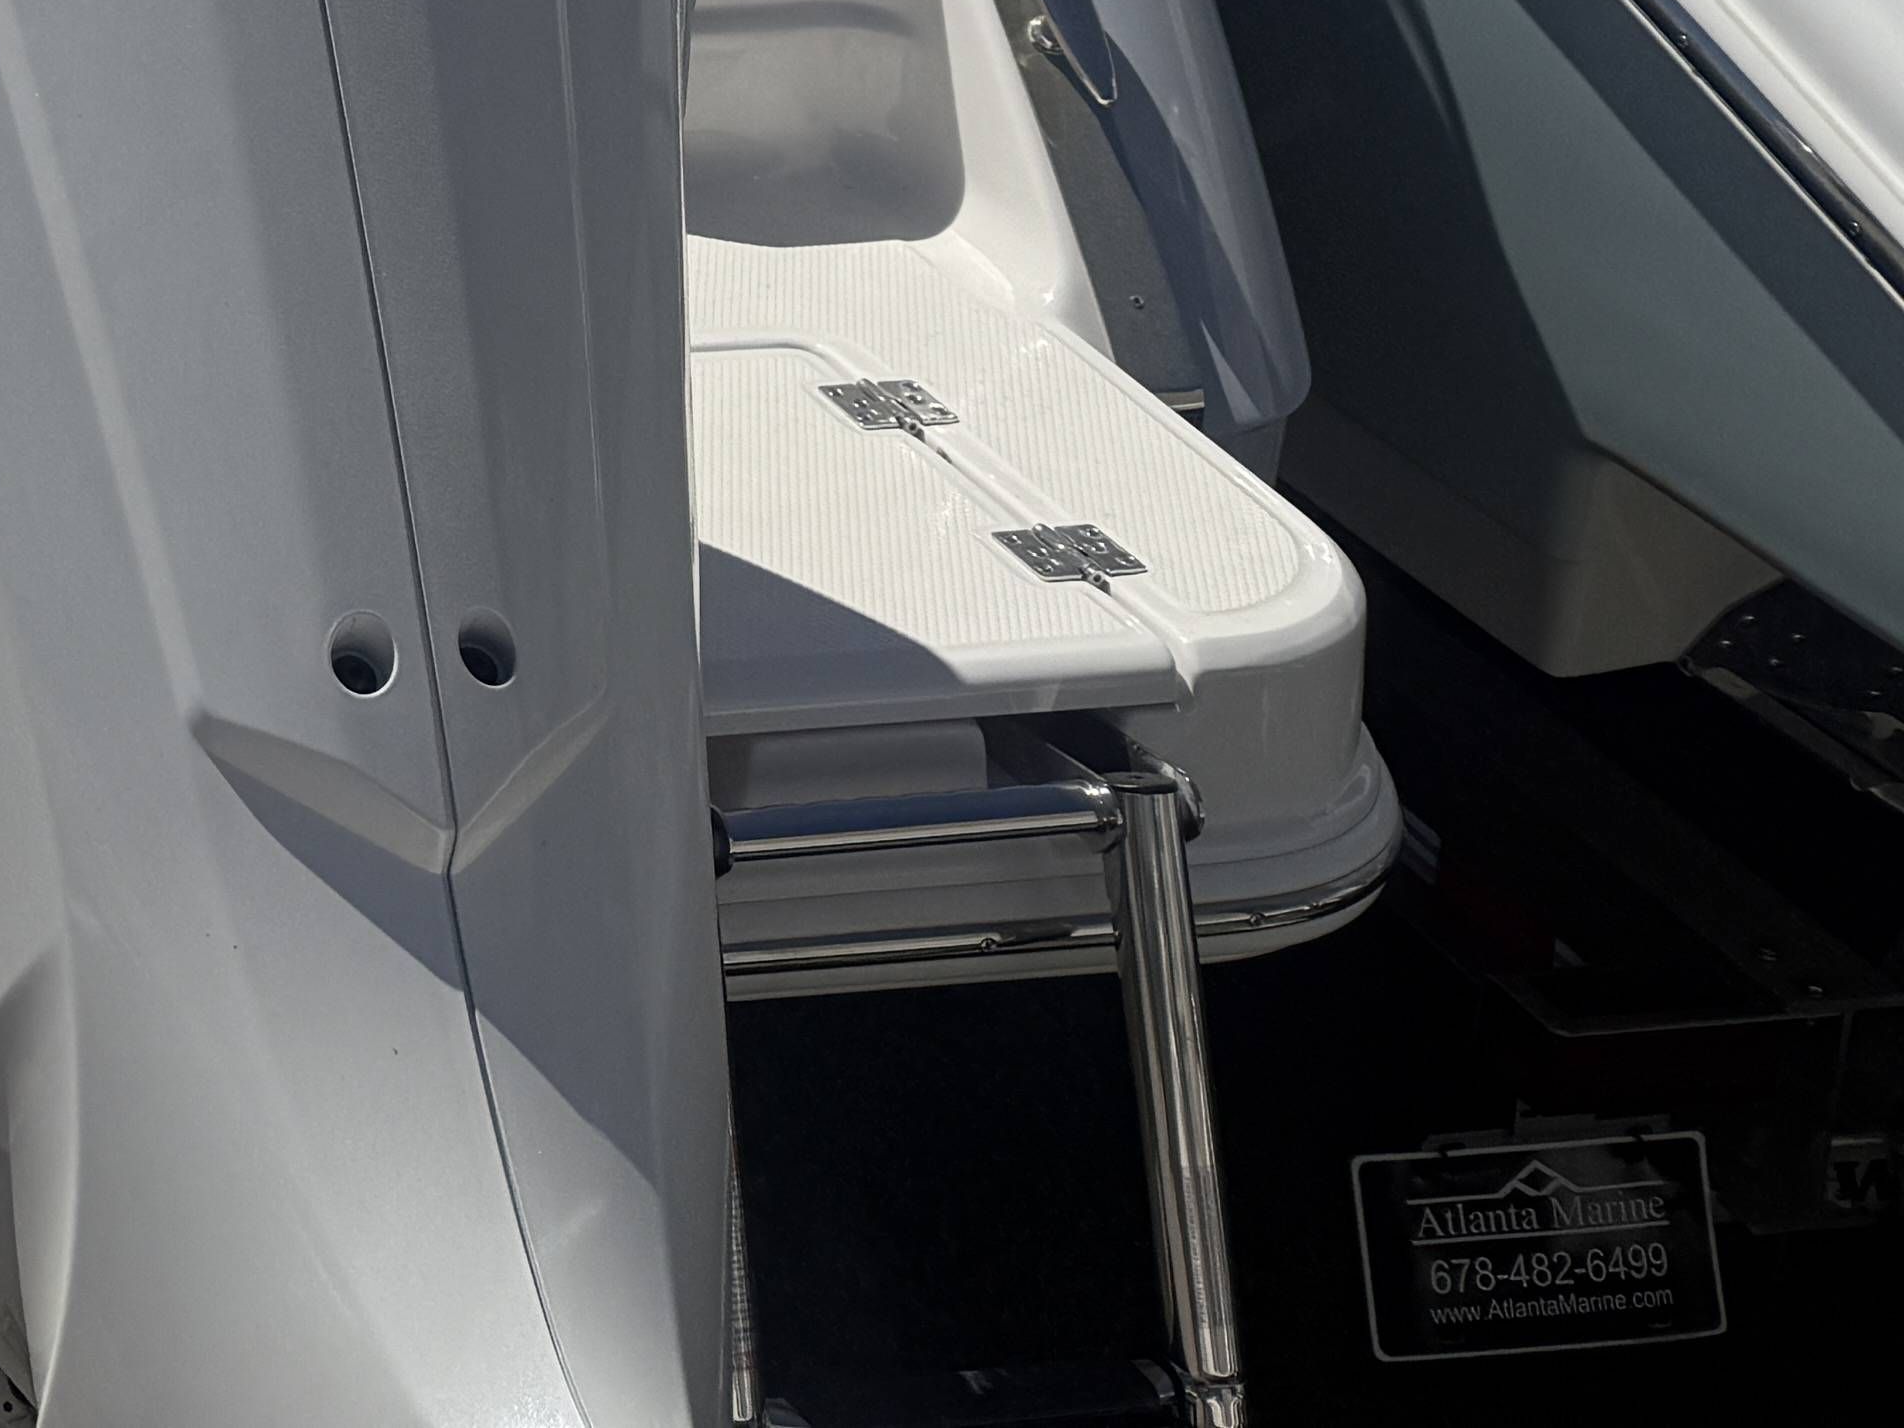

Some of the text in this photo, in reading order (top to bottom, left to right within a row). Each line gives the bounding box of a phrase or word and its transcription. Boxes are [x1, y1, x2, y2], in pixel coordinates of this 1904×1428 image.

[1418, 1190, 1666, 1238] Atlanta Marine
[1431, 1242, 1669, 1295] 678-482-6499
[1430, 1287, 1674, 1325] www.AtlantaMarine.com
